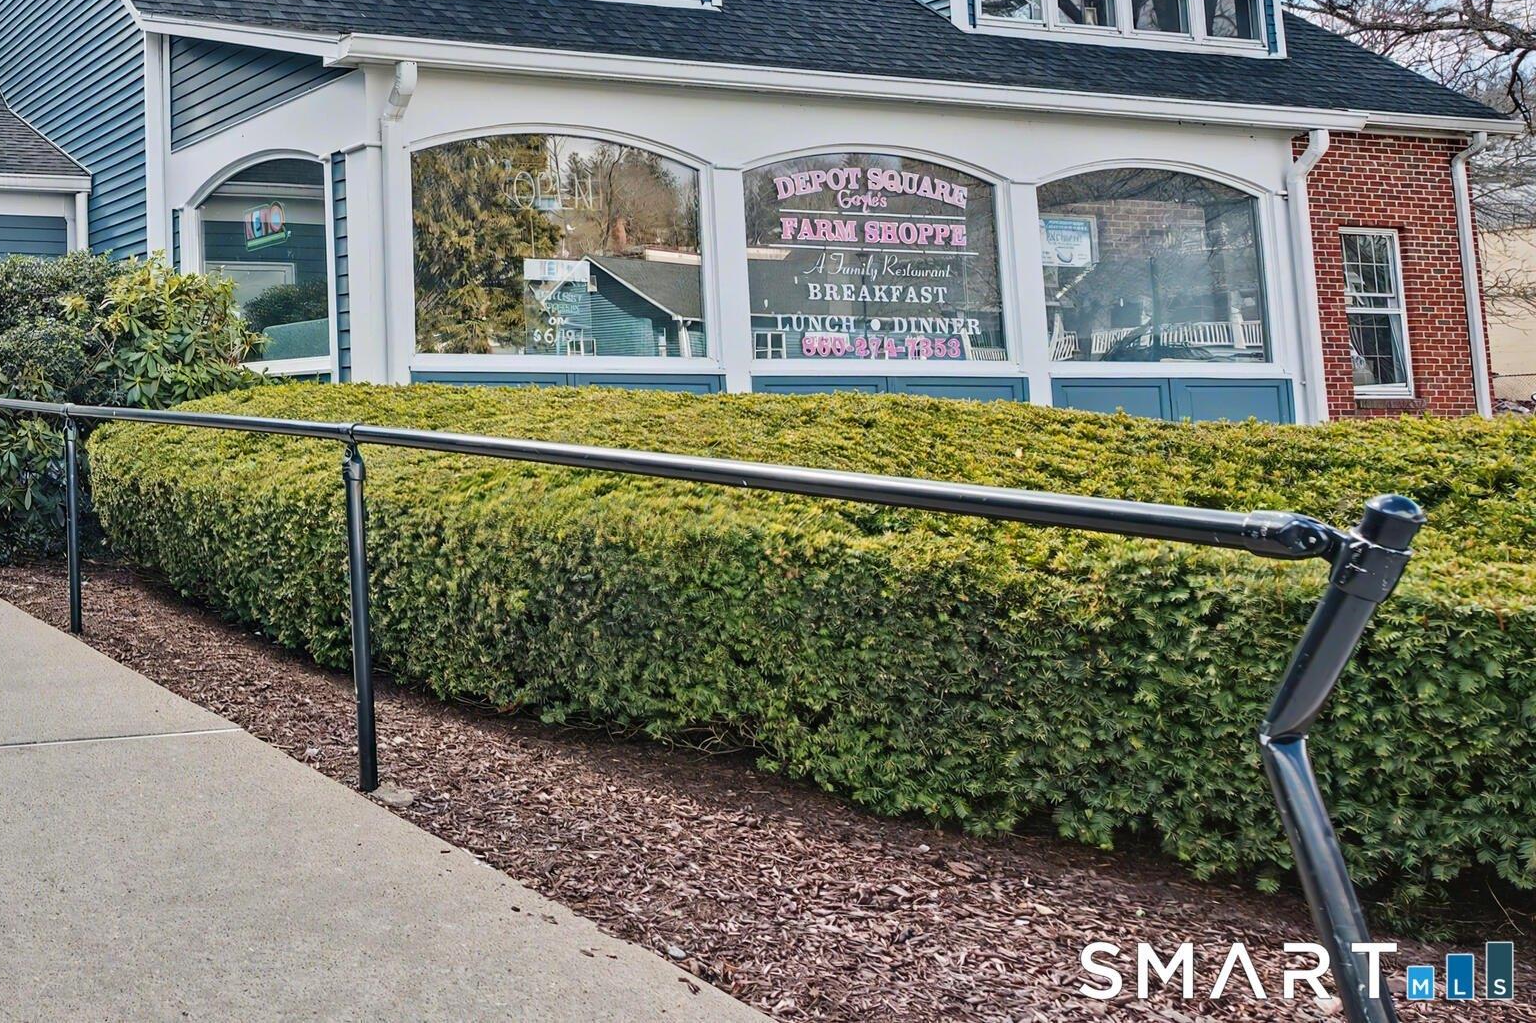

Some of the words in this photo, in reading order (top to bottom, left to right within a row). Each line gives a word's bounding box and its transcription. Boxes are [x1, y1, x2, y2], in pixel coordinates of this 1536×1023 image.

[774, 167, 862, 200] DEPOT
[867, 167, 968, 209] SQUARE
[779, 217, 858, 242] FARM
[864, 220, 967, 247] SHOPPE
[804, 253, 825, 274] A
[829, 253, 878, 280] Family
[881, 255, 952, 278] Restaurant
[807, 283, 947, 304] BREAKFAST
[775, 314, 857, 333] LUNCH
[893, 317, 981, 335] DINNER
[802, 335, 961, 358] 860-274-7353
